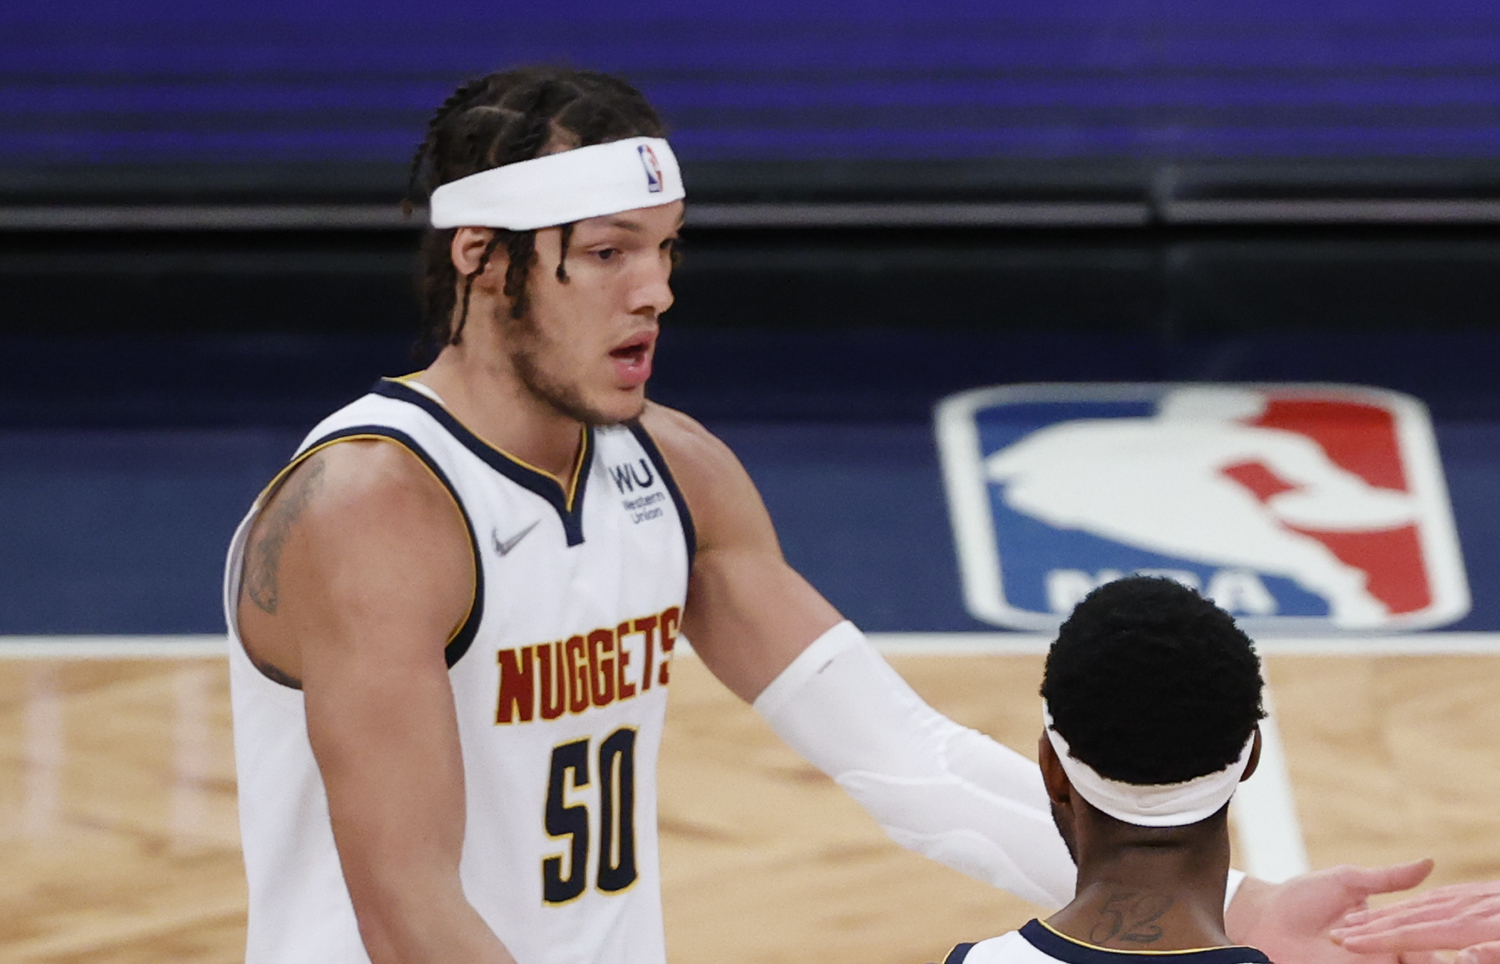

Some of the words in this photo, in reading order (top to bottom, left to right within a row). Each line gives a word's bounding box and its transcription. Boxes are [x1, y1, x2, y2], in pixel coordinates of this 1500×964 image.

[608, 456, 654, 495] WU
[1046, 568, 1279, 614] NA
[494, 606, 680, 726] NUGGETS
[541, 724, 639, 907] 50
